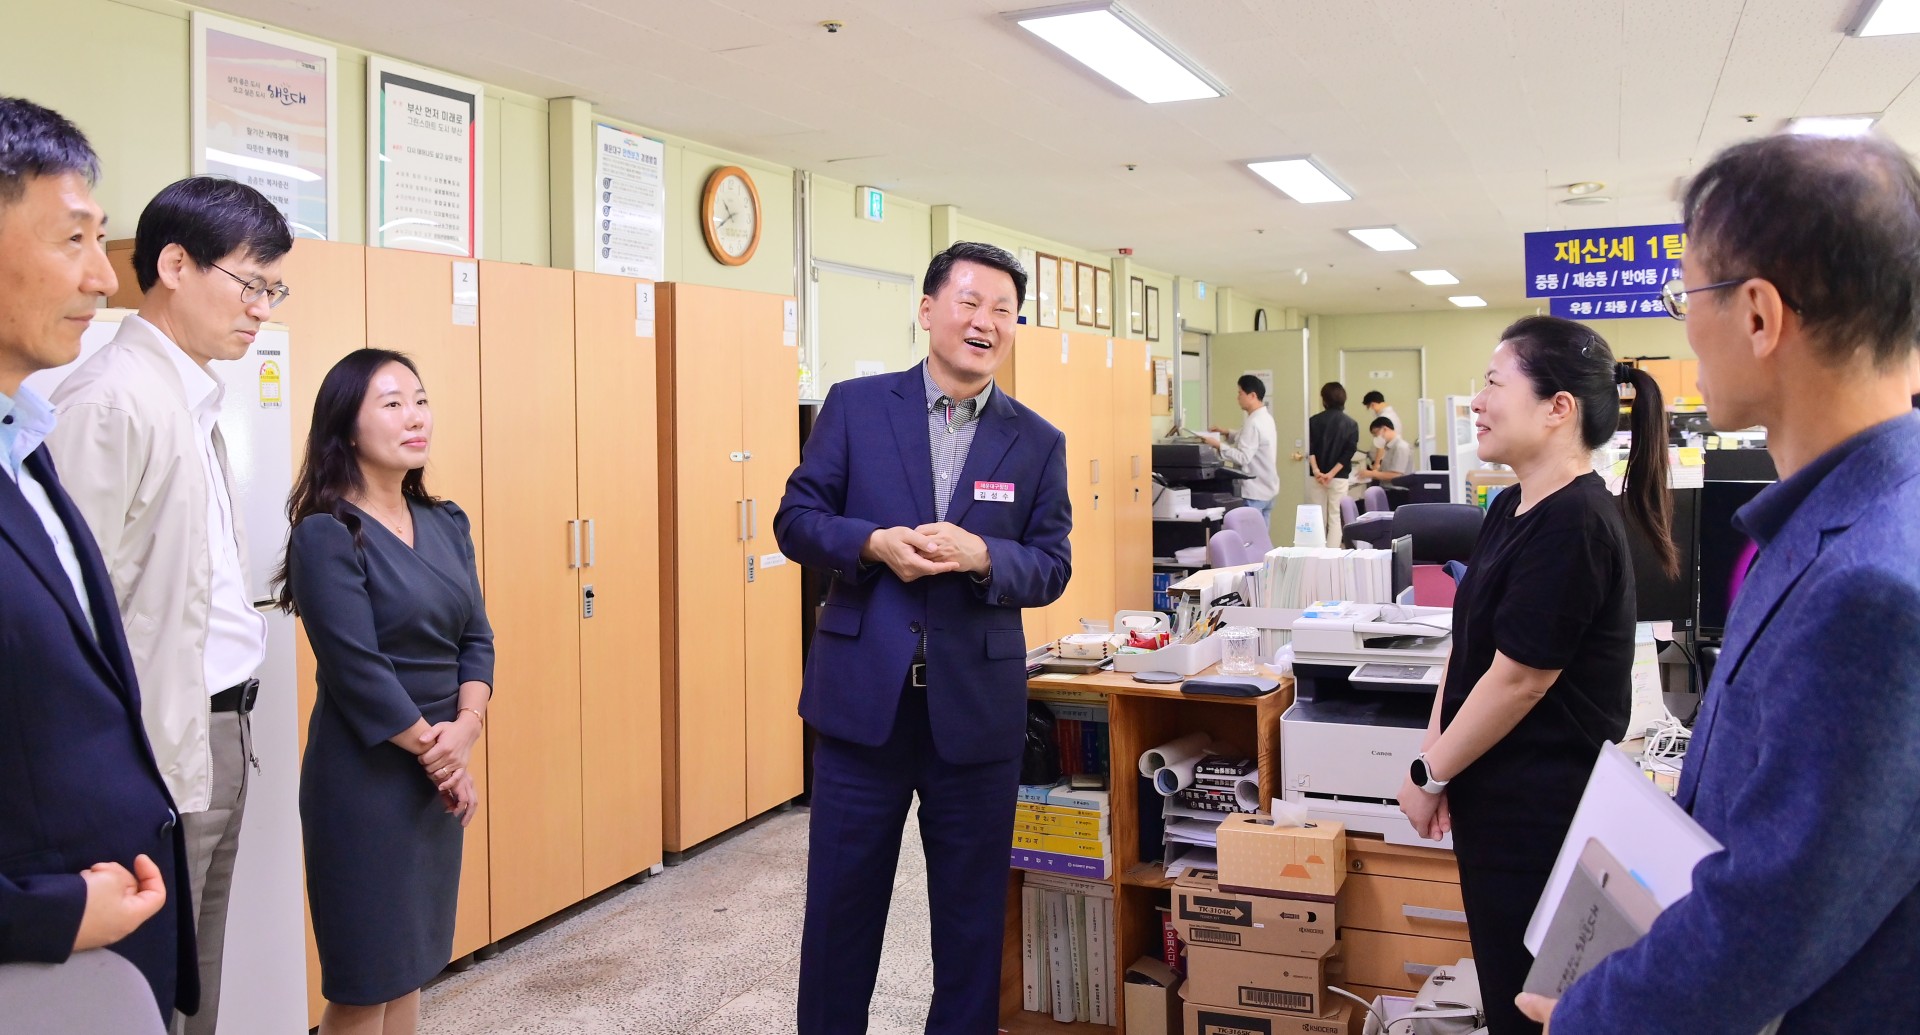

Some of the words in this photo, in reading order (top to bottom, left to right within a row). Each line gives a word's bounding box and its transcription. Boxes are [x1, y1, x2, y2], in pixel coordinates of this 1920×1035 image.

[267, 84, 306, 106] 해운대
[407, 103, 422, 116] 부산
[424, 106, 439, 120] 먼저
[441, 111, 463, 125] 미래로
[438, 123, 450, 133] 도시
[451, 126, 463, 137] 부산
[1554, 235, 1635, 265] 재산세
[1646, 236, 1658, 259] 1
[462, 272, 469, 283] 2
[1535, 274, 1560, 291] 중동
[1572, 271, 1608, 288] 재송동
[1621, 268, 1658, 286] 반여동
[643, 292, 648, 303] 3
[1569, 302, 1592, 315] 우동
[1604, 300, 1628, 314] 좌동
[1640, 299, 1667, 312] 송정
[1199, 906, 1232, 916] TK-3104K
[1309, 1025, 1338, 1034] KYOCERA
